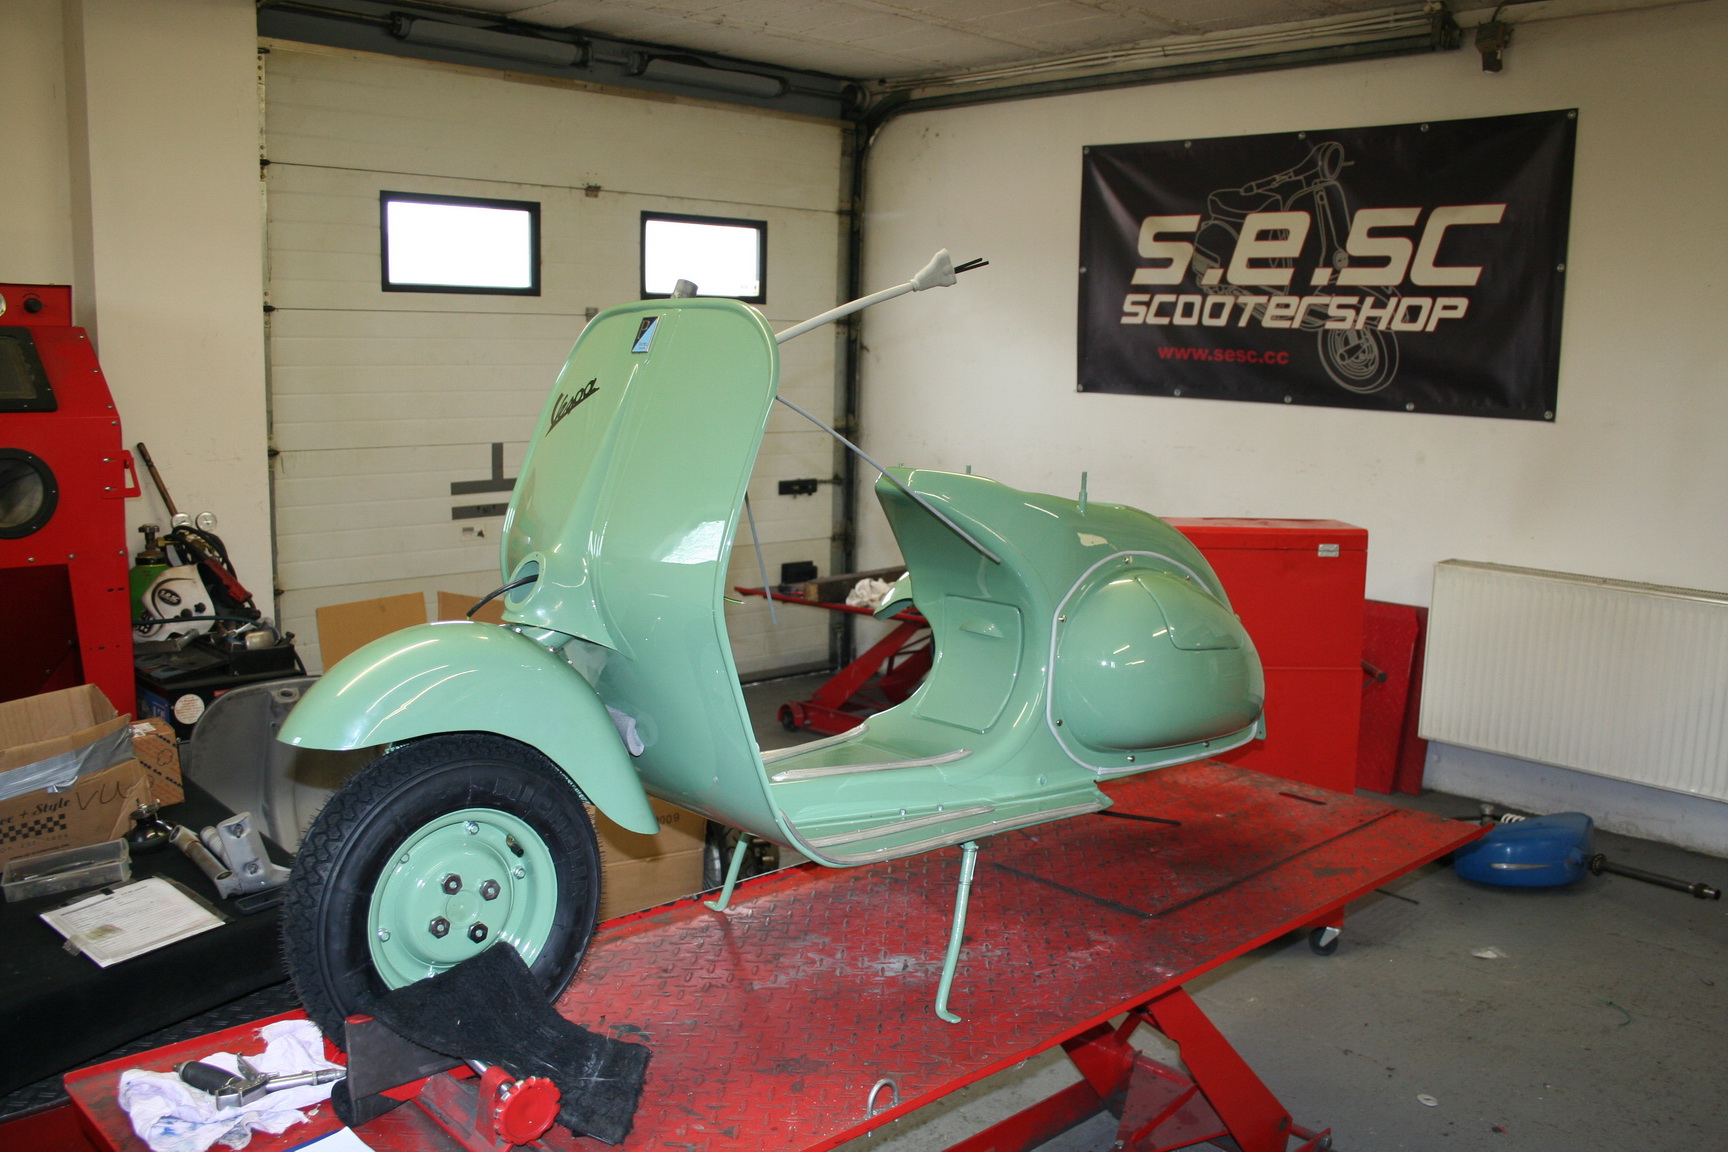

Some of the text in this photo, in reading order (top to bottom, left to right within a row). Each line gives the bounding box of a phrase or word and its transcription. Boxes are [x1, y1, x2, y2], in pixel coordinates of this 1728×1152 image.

[1158, 346, 1290, 365] www.sesc.cc
[33, 797, 72, 816] Style
[656, 812, 680, 825] 009
